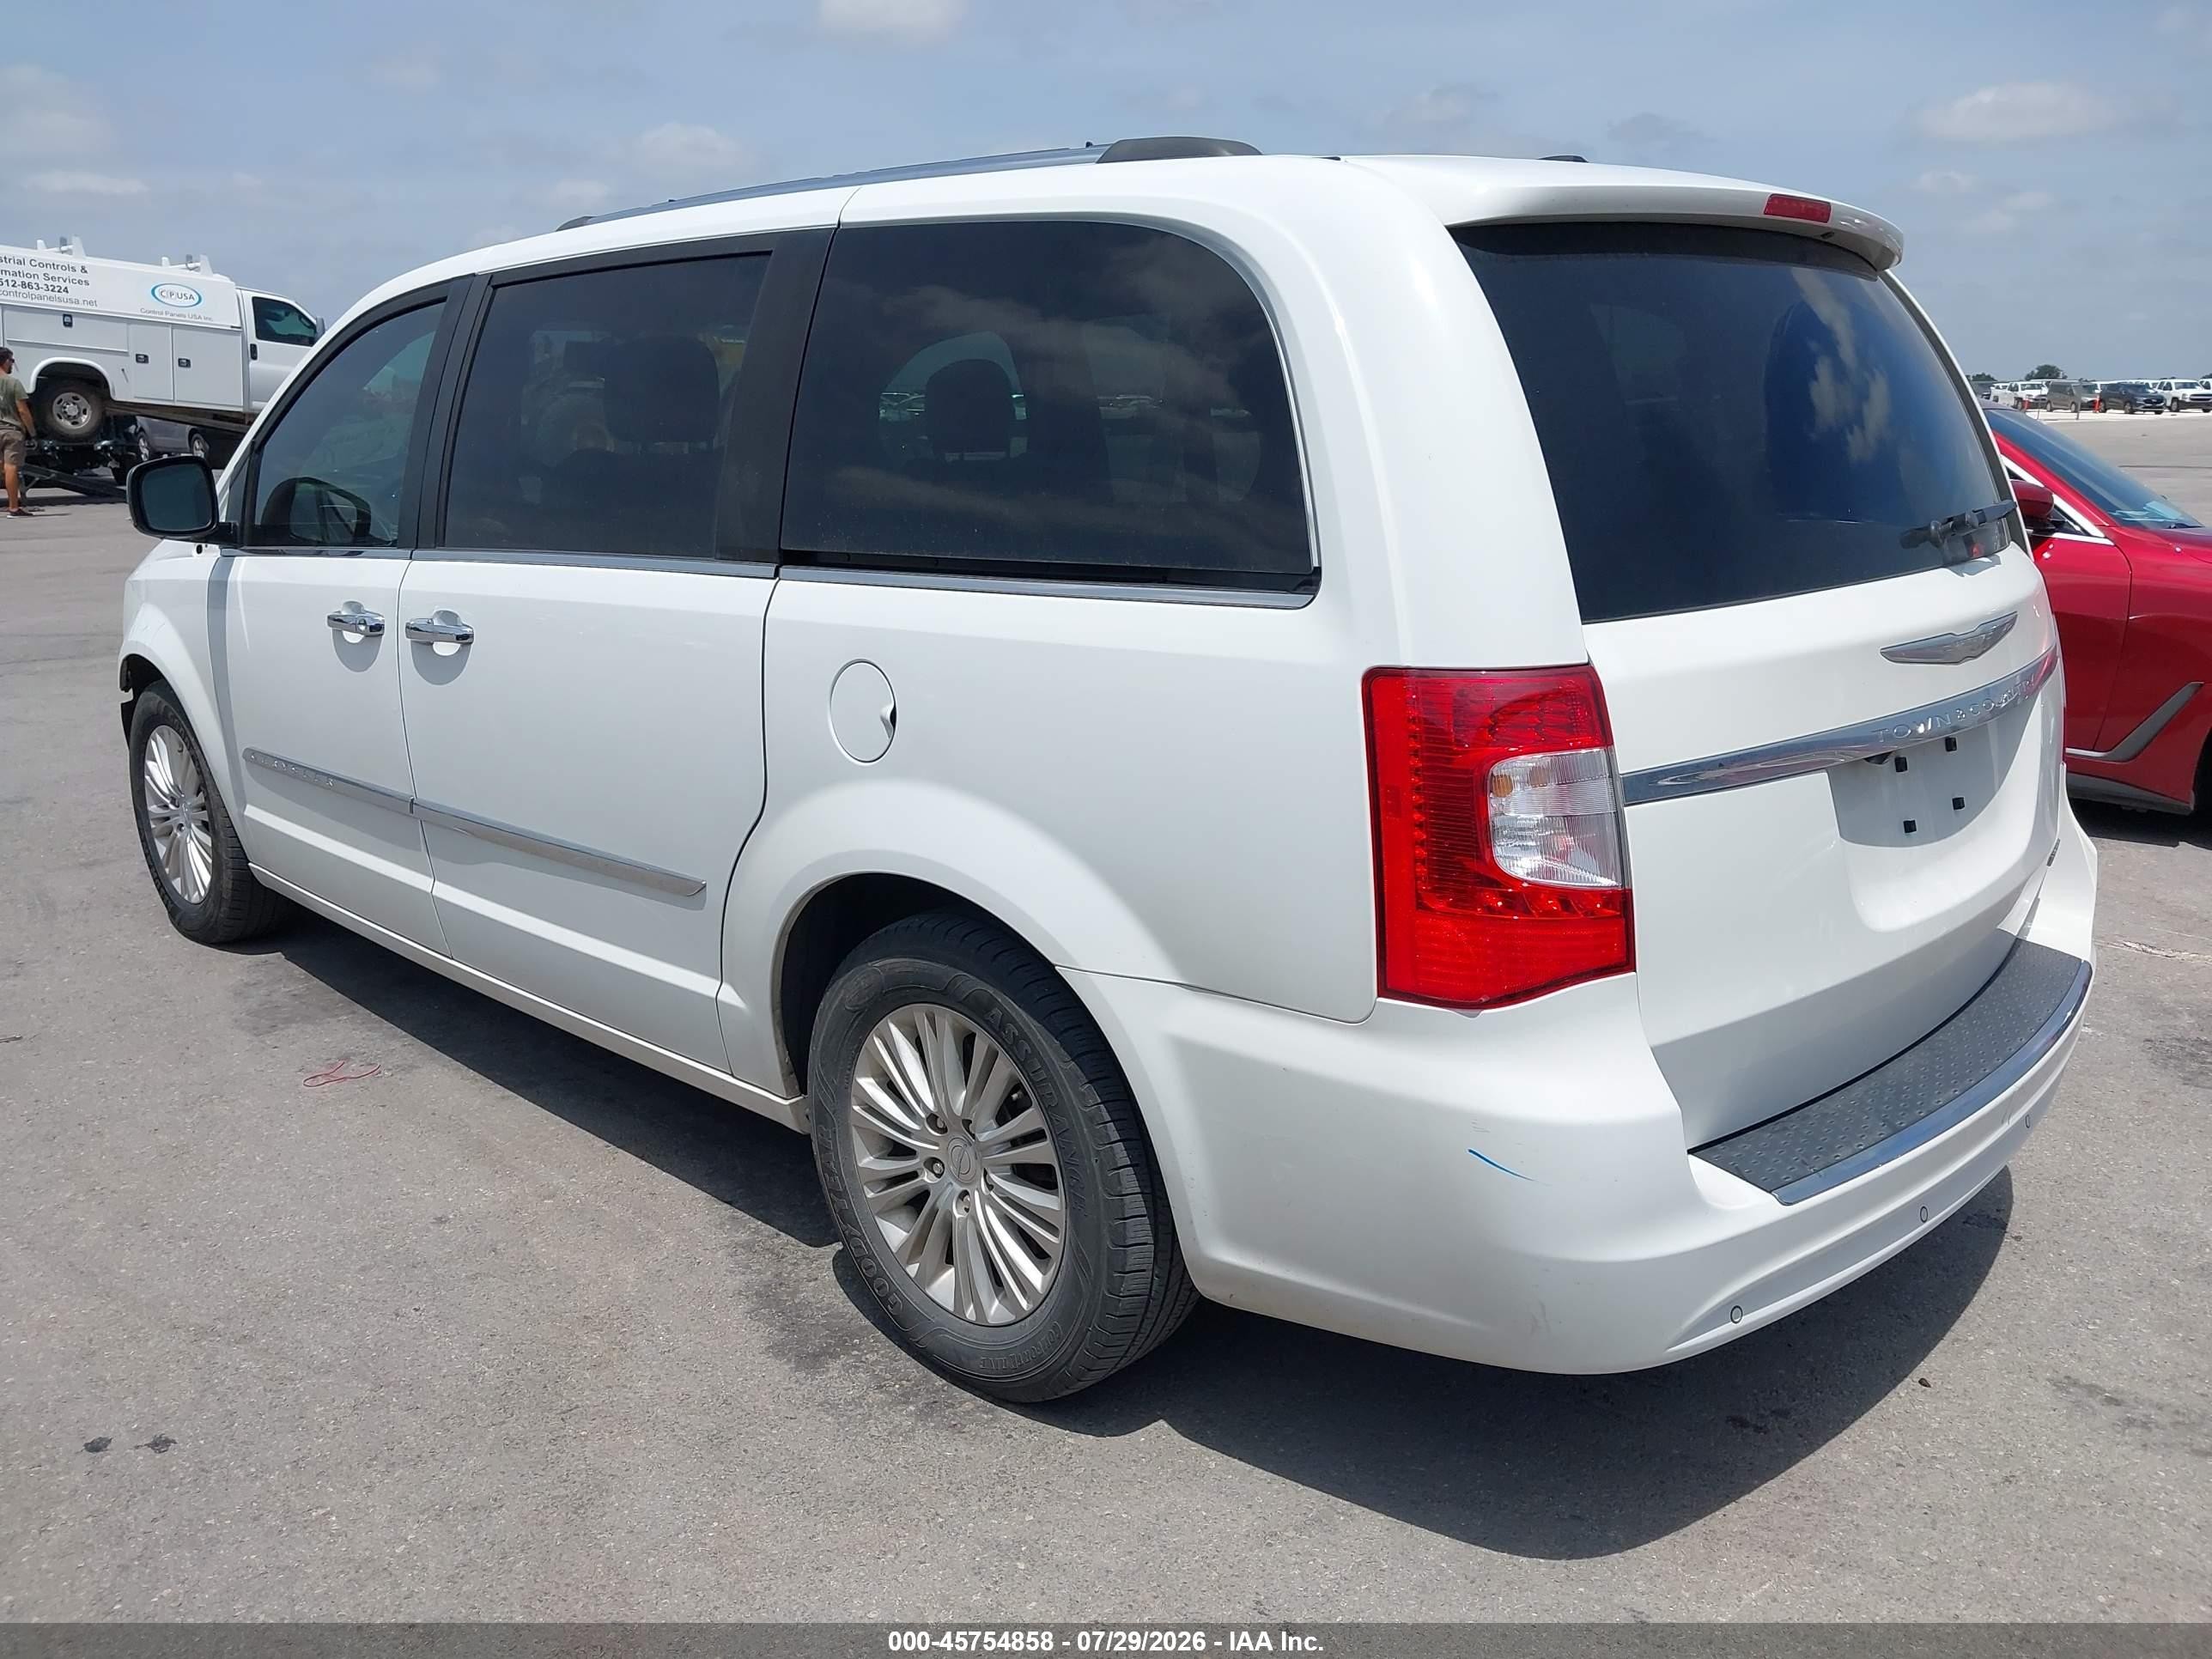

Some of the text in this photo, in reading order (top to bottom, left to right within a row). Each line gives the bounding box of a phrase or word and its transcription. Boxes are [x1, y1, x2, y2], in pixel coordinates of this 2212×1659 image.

[29, 258, 76, 273] Controls
[81, 265, 88, 275] &
[43, 273, 90, 286] Services
[140, 307, 164, 316] Control
[165, 311, 187, 319] Panels
[1872, 713, 1953, 743] TOWN
[818, 1125, 903, 1315] GOODYEAR
